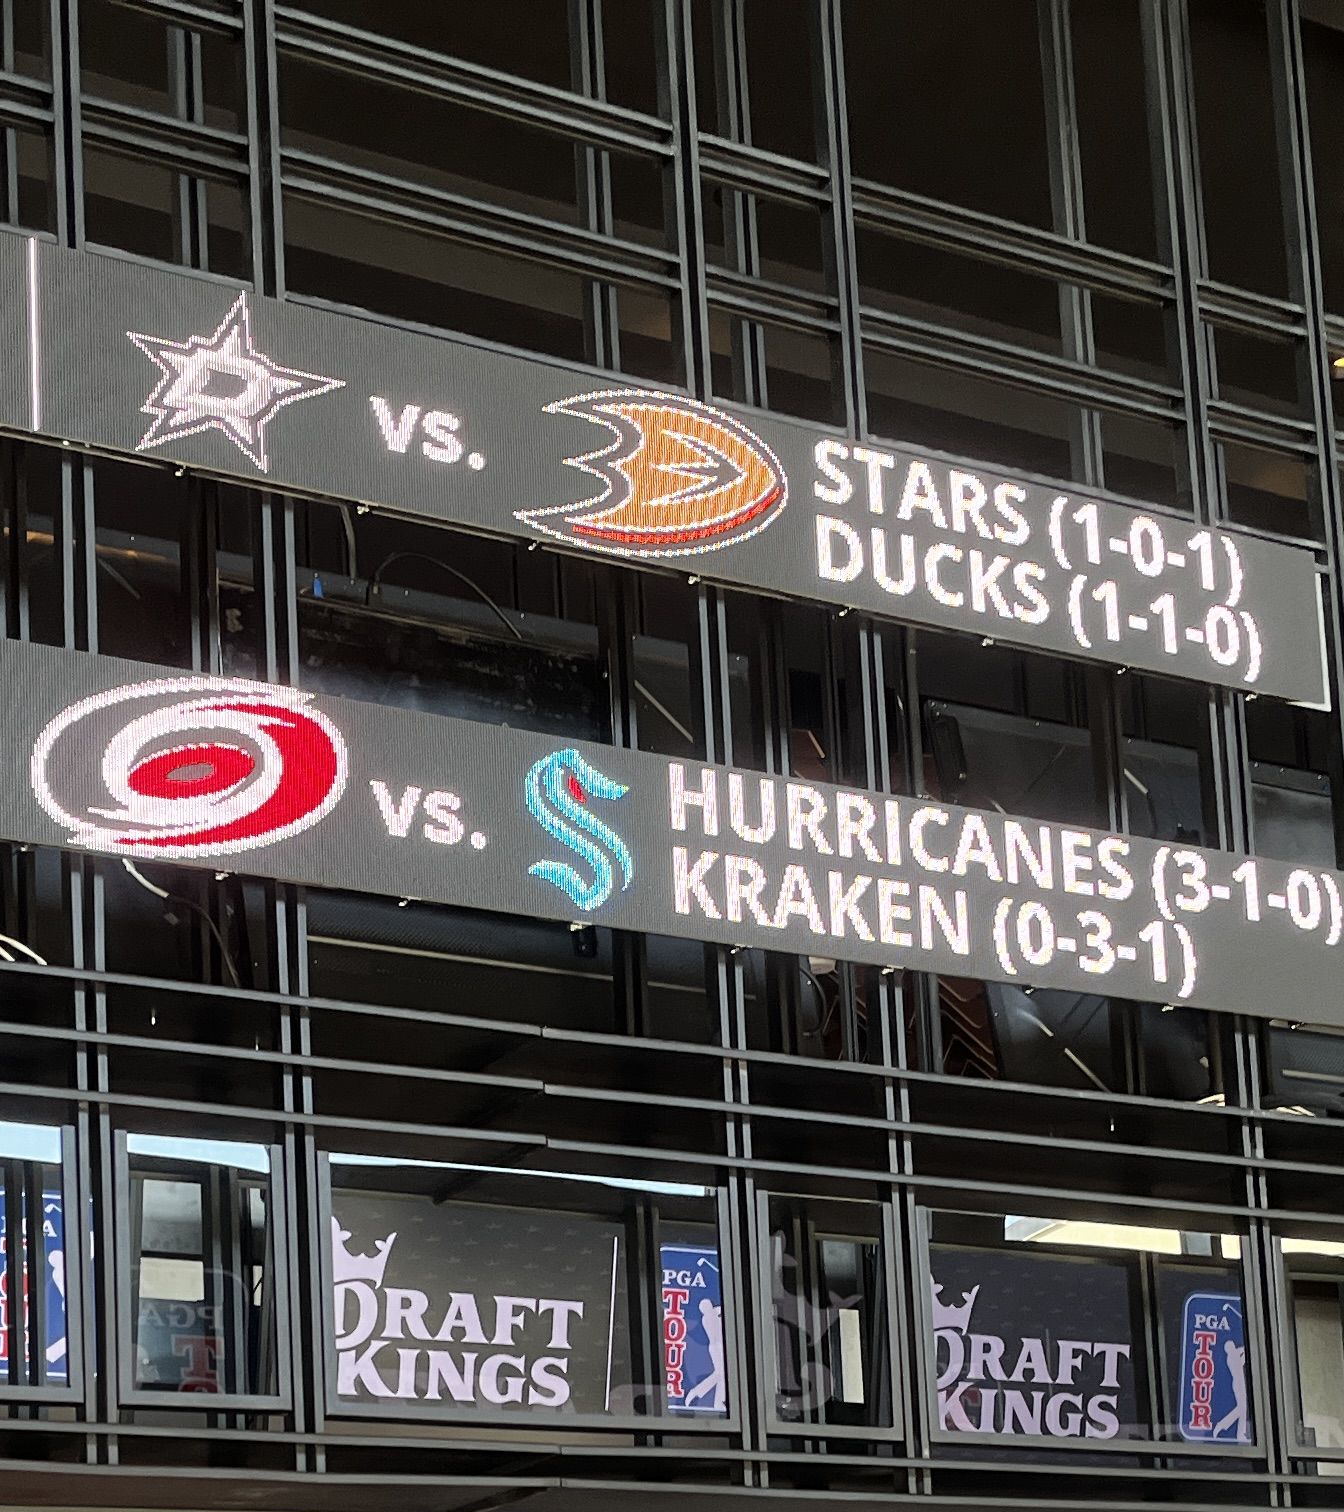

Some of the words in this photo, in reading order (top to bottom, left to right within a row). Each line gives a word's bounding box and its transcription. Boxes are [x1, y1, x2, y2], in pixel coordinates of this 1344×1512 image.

[812, 440, 1031, 549] STARS
[1050, 497, 1245, 606] (1-0-1)
[814, 515, 1052, 625] DUCKS
[1068, 575, 1262, 684] (1-1-0)
[669, 761, 1135, 903] HURRICANES
[1153, 846, 1343, 946] (3-1-0)
[672, 846, 970, 958] KRAKEN
[993, 898, 1198, 1000] (0-3-1)
[333, 1280, 584, 1353] DRAFT
[662, 1269, 707, 1289] PGA
[1194, 1313, 1231, 1331] PGA
[336, 1339, 571, 1408] KINGS
[662, 1288, 690, 1399] TOUR
[1188, 1330, 1218, 1431] TOUR
[938, 1381, 1121, 1440] KINGS
